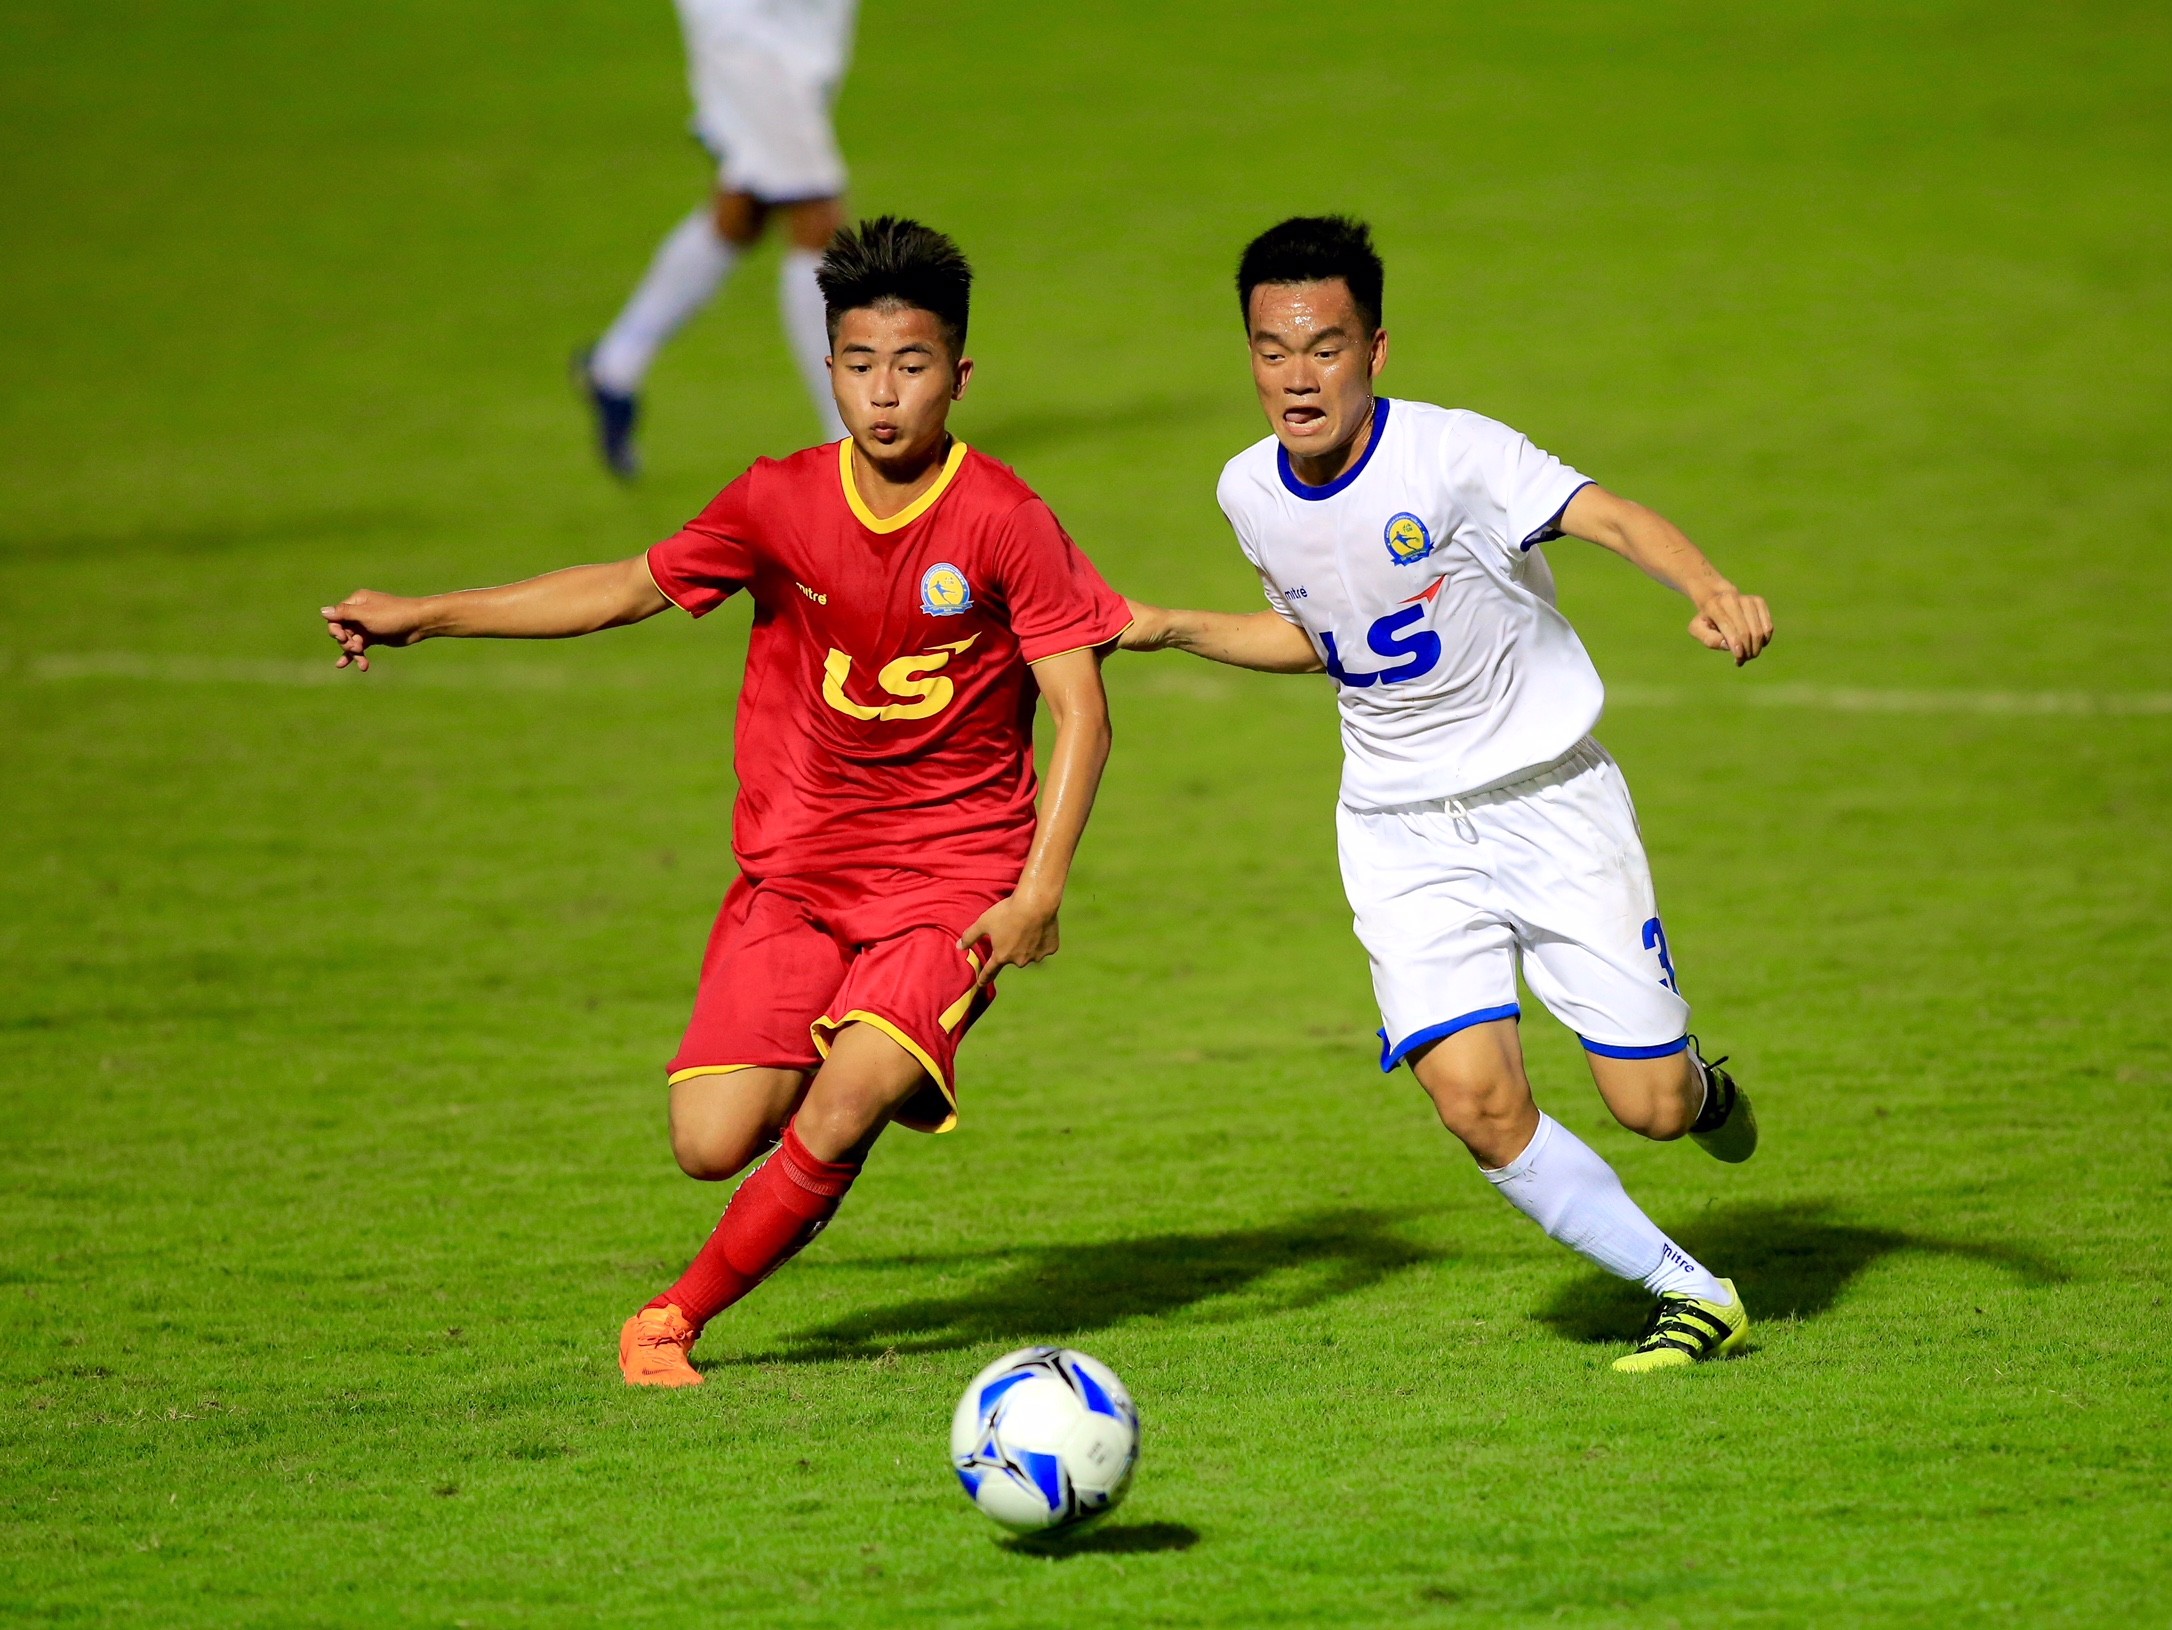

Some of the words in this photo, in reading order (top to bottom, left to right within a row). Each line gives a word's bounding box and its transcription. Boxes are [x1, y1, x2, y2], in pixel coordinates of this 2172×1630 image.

[1284, 587, 1308, 600] mitre
[1319, 603, 1442, 688] LS
[822, 648, 954, 721] LS
[1662, 1243, 1695, 1273] mitre
